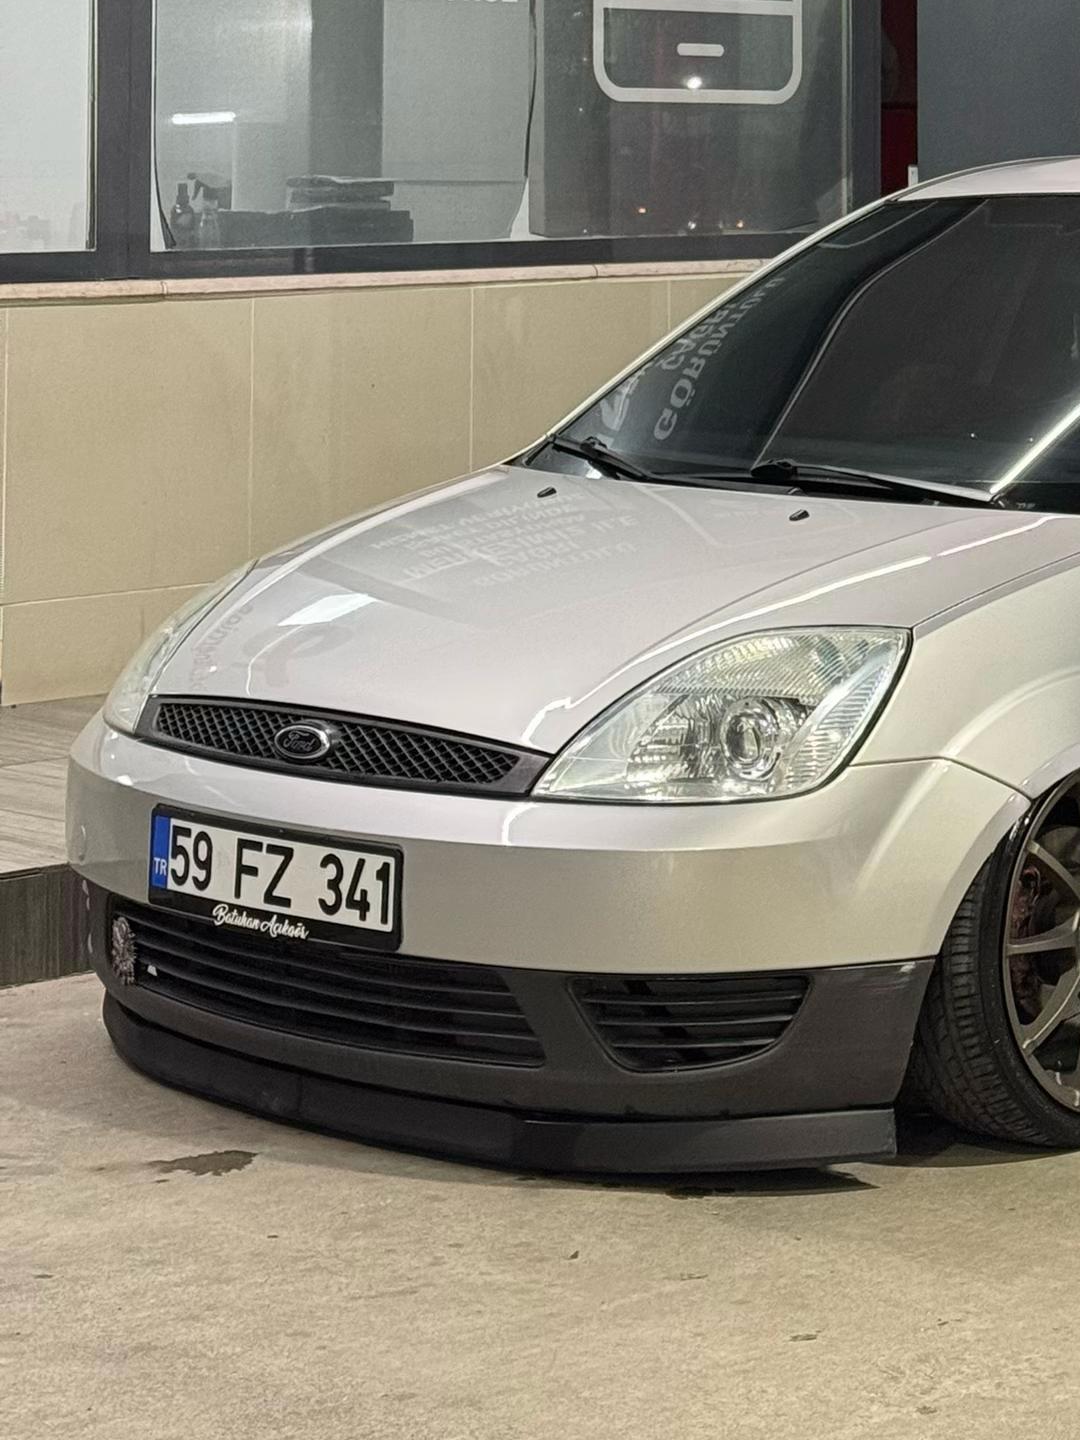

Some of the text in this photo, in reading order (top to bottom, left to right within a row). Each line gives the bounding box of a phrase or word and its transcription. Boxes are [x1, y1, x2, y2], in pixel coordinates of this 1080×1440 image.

[282, 729, 317, 752] Ford
[154, 857, 167, 876] TR
[168, 824, 391, 926] 59 FZ 341
[212, 903, 260, 931] Batuhan
